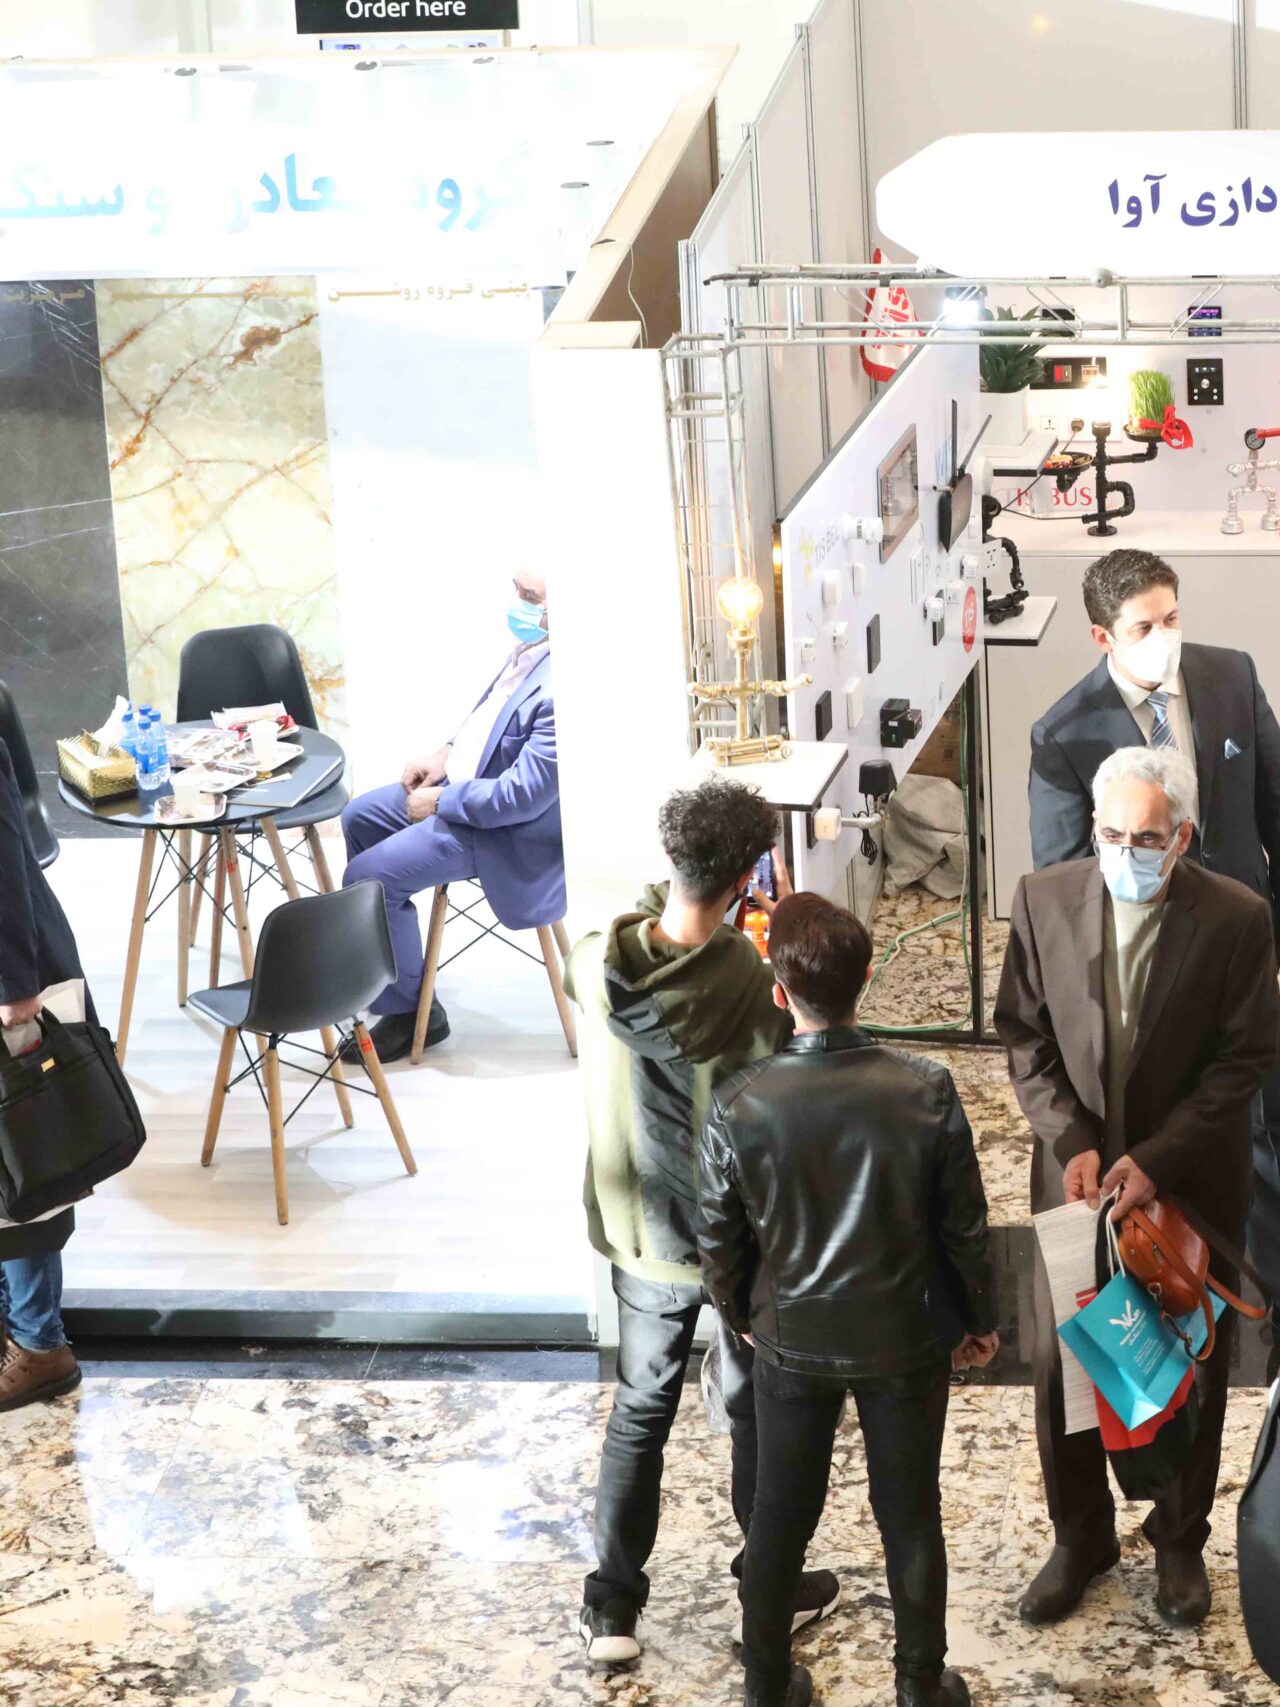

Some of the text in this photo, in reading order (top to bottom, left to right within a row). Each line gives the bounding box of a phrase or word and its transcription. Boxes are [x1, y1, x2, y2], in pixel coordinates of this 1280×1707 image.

[345, 0, 466, 18] Order here
[1108, 173, 1168, 228] آوا
